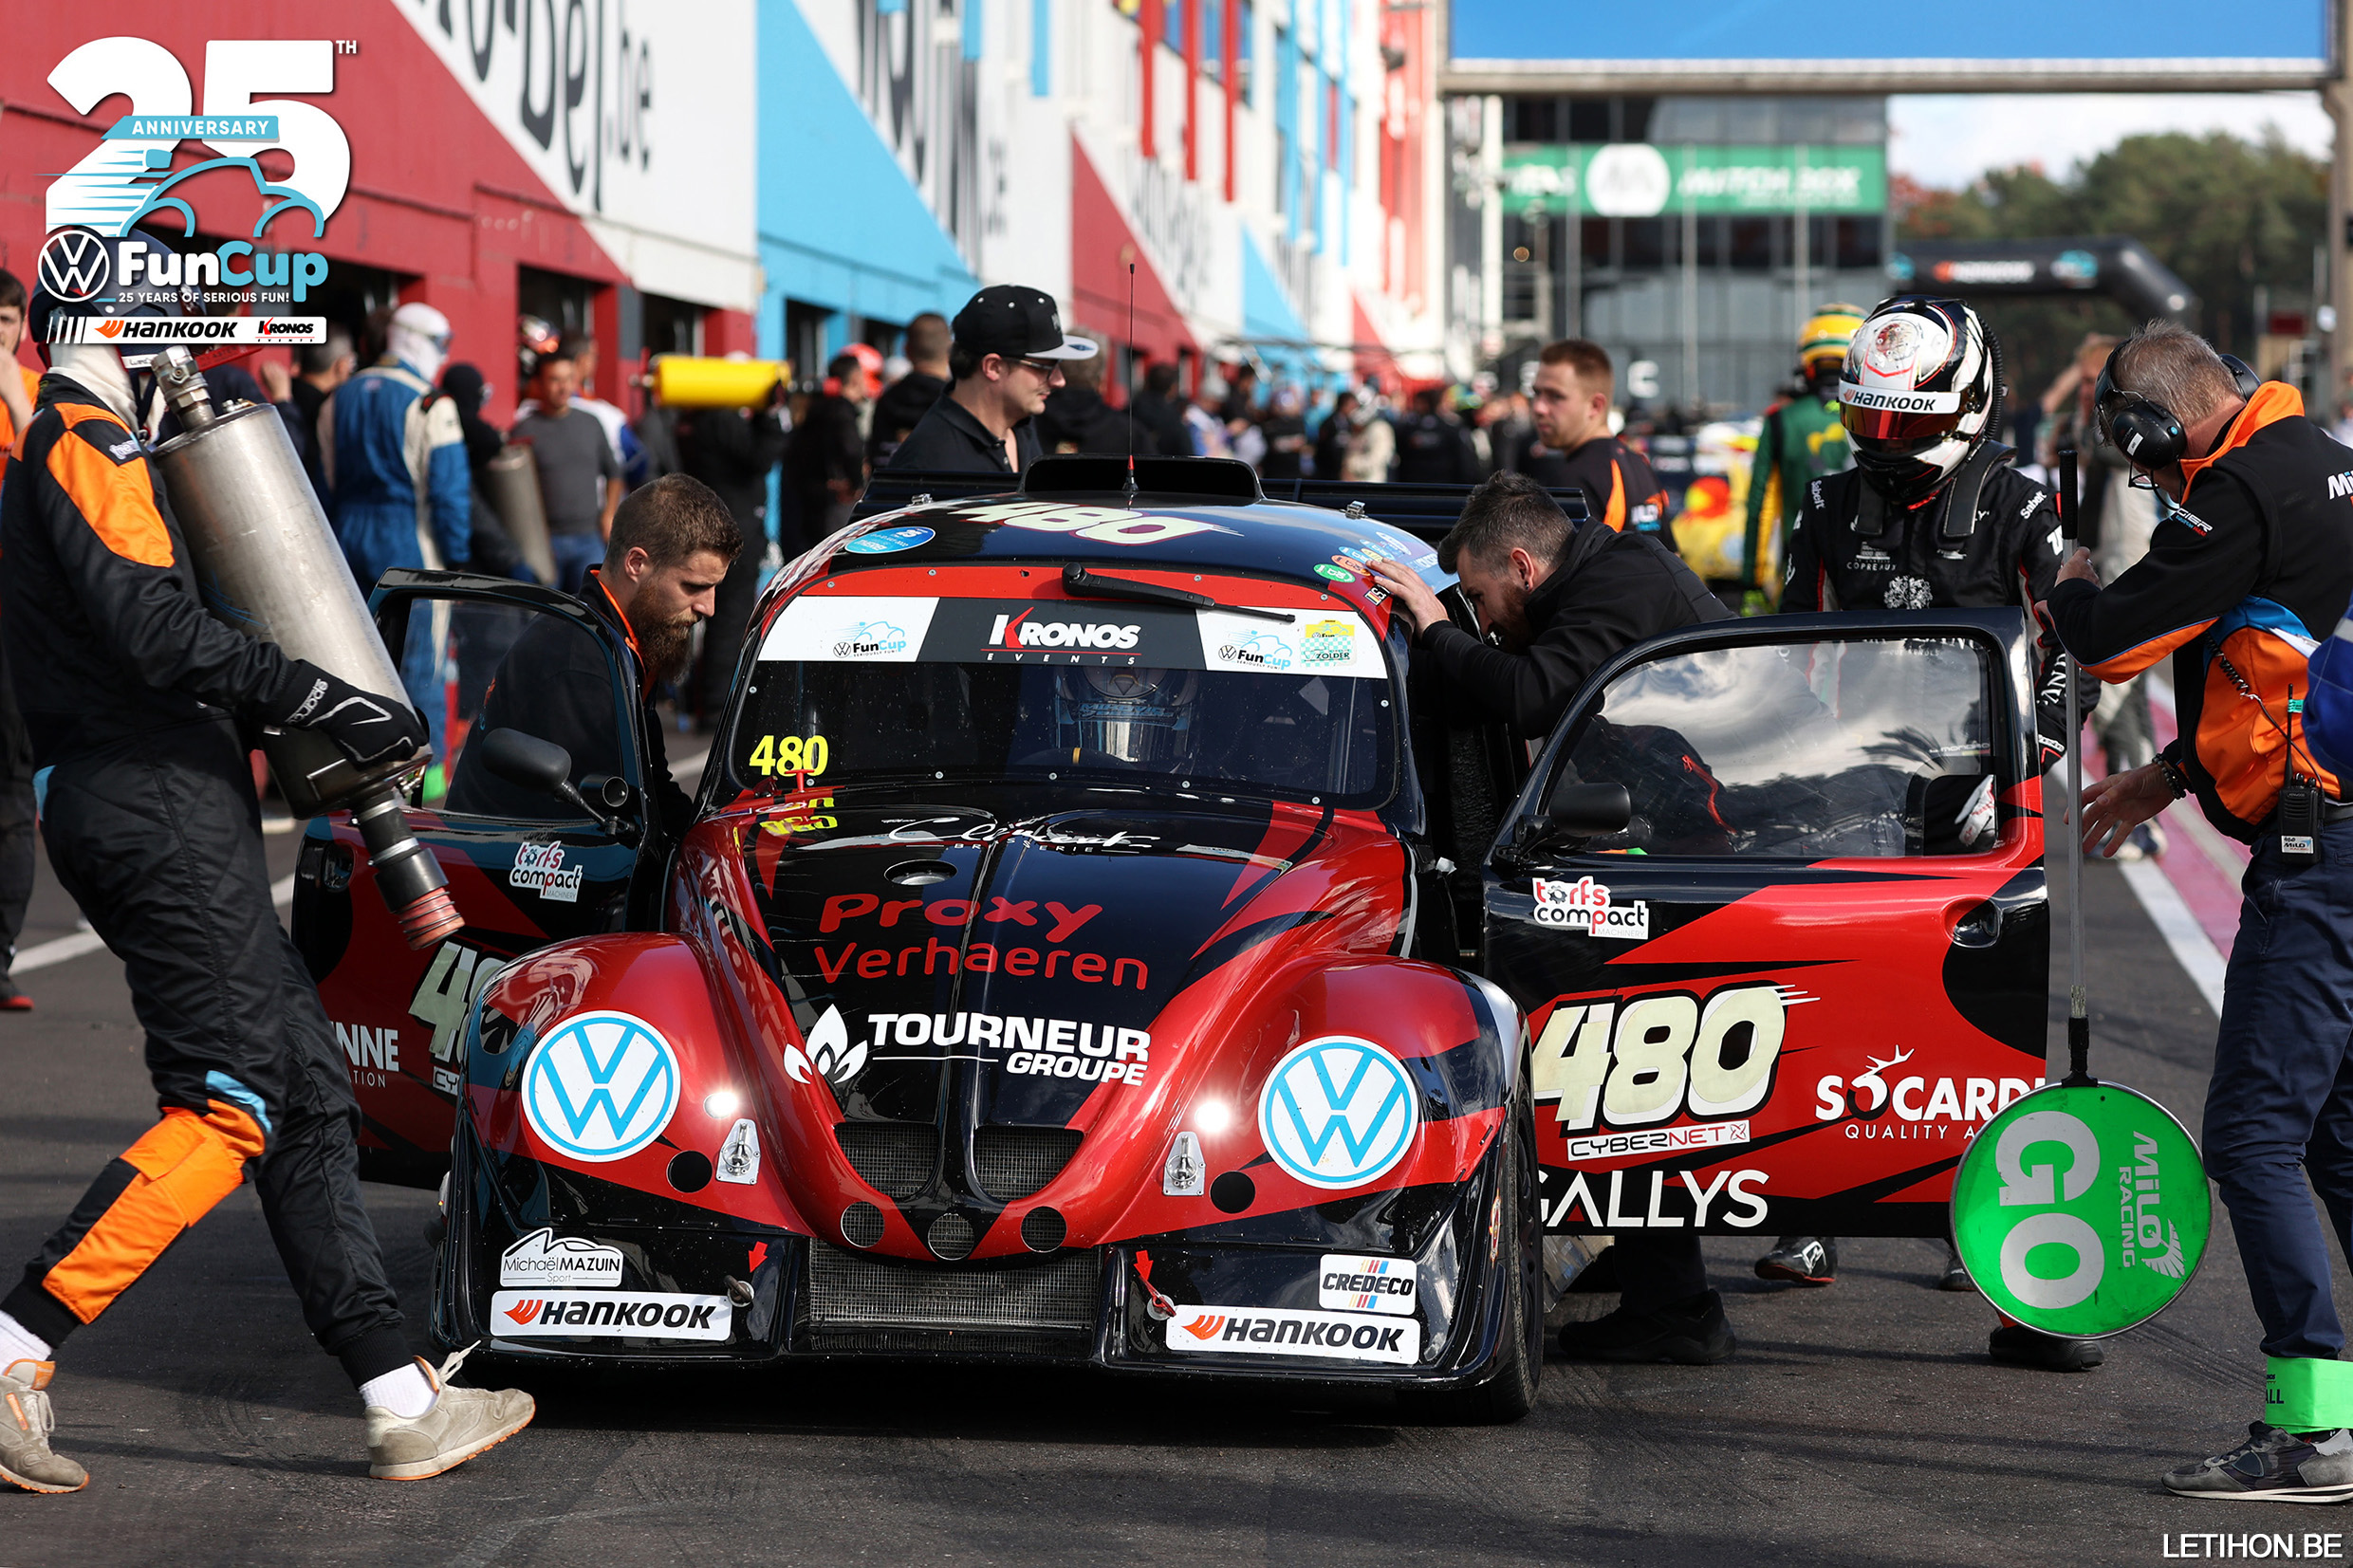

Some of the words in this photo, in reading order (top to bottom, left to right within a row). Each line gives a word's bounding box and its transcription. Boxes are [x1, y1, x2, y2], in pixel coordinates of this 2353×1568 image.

[2020, 490, 2047, 520] Sabelt
[947, 502, 1217, 544] 480
[989, 606, 1141, 649] KRONOS
[853, 639, 907, 654] FunCup
[987, 653, 1136, 665] EVENTS
[1237, 649, 1291, 670] FunCup
[749, 735, 829, 777] 480
[512, 864, 582, 895] compact
[547, 890, 577, 901] MACHINERY
[820, 894, 1102, 944] Proxy
[1537, 905, 1645, 935] compact
[1598, 928, 1645, 938] MACHINERY
[815, 937, 1149, 990] Verhaeren
[869, 1012, 1151, 1061] TOURNEUR
[1006, 1051, 1148, 1086] GROUPE
[1532, 985, 1789, 1130] 480
[1815, 1073, 2046, 1122] SOCARD
[1844, 1124, 1948, 1139] QUALITY
[1995, 1110, 2105, 1309] GO
[2119, 1166, 2136, 1268] RACING
[547, 1272, 571, 1283] Sport
[1322, 1272, 1415, 1297] CREDECO
